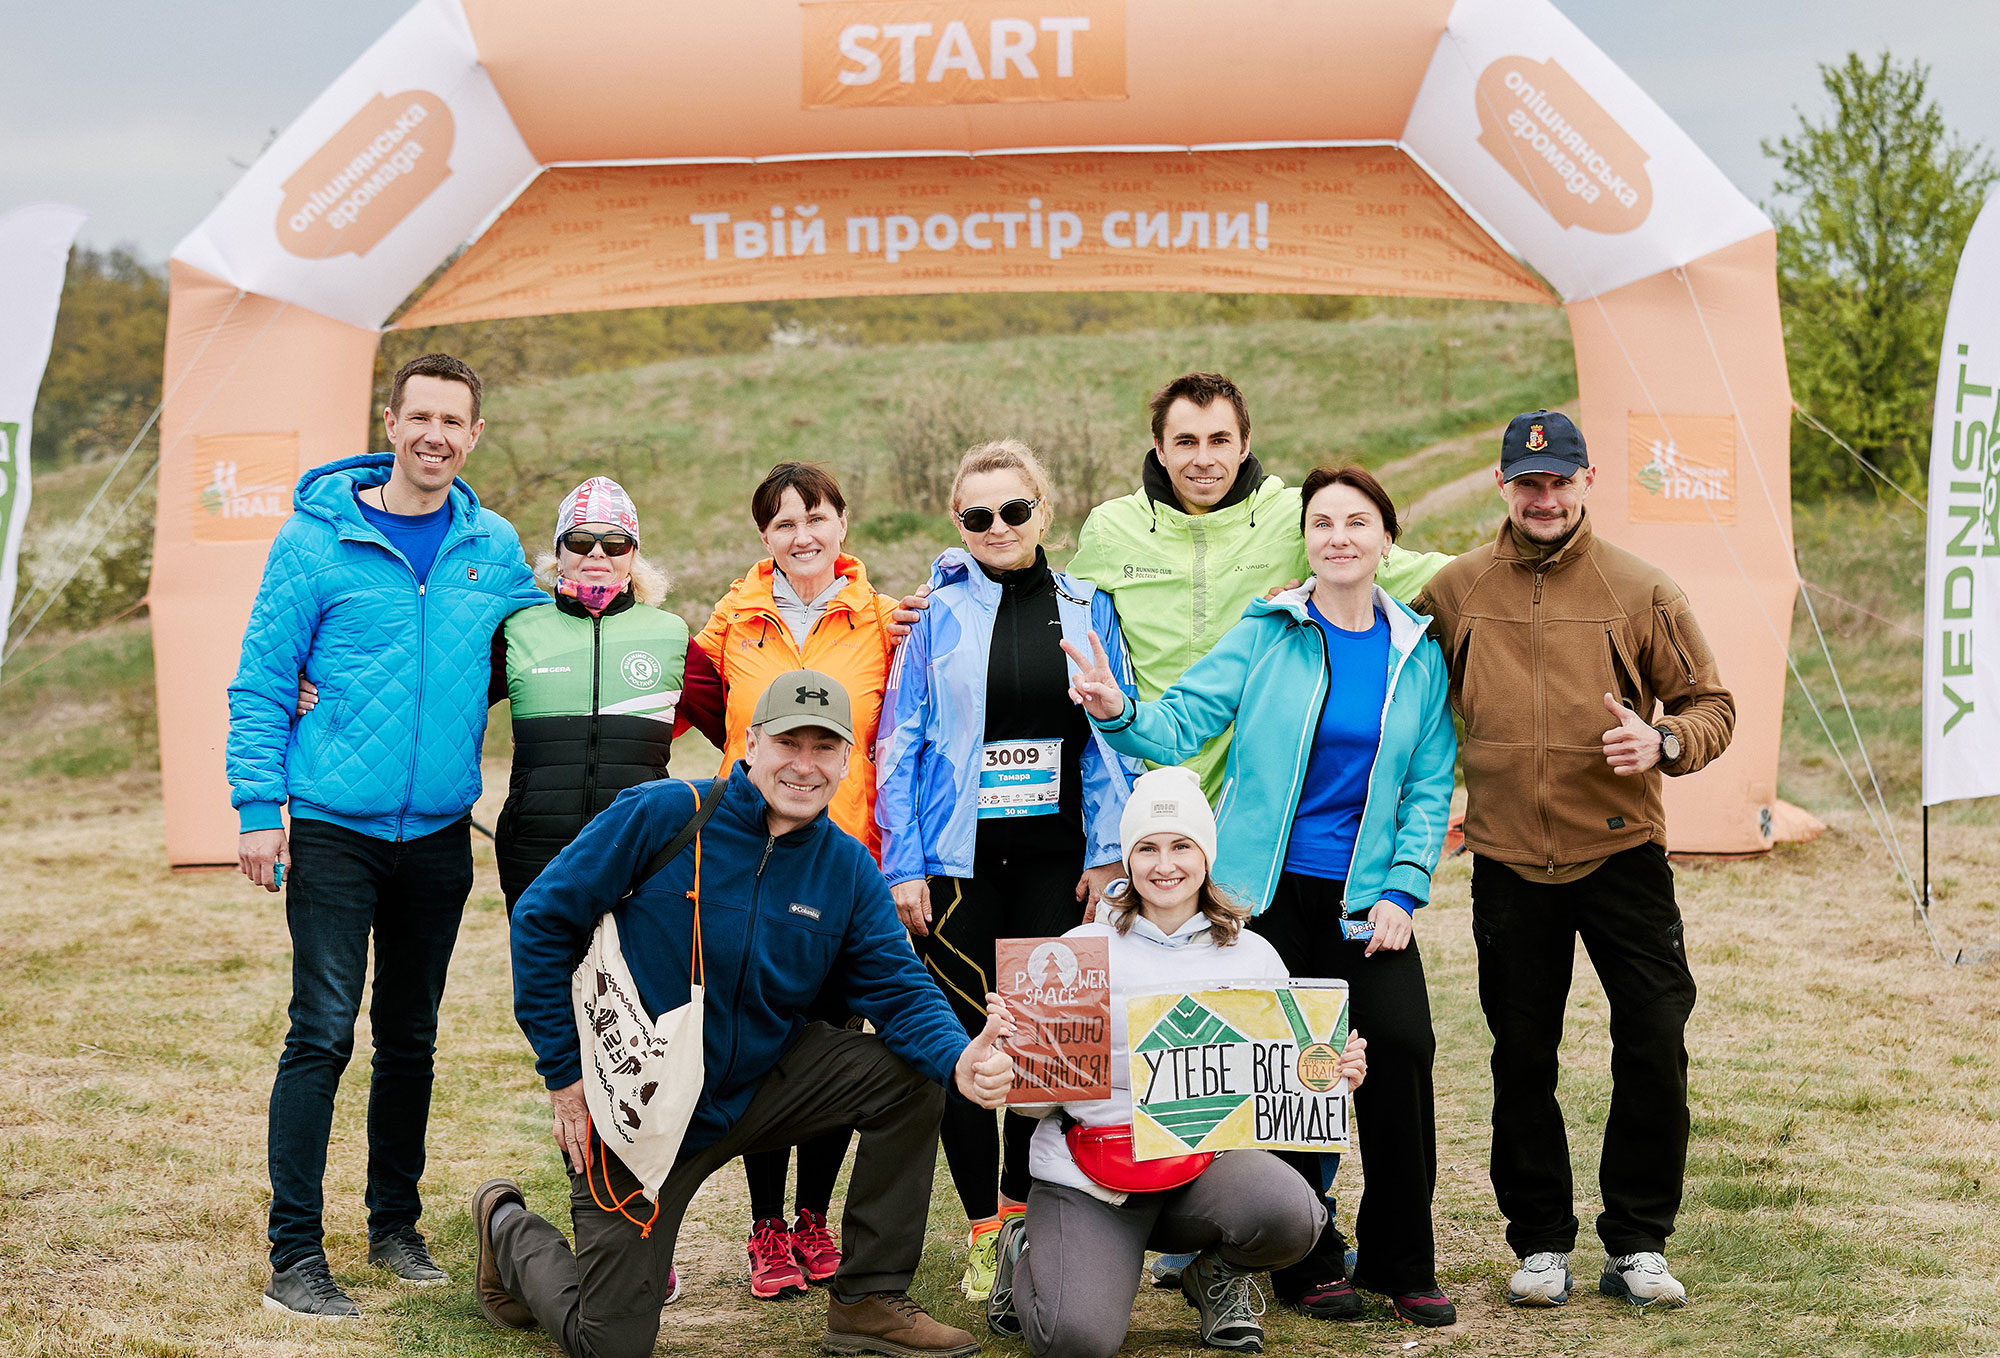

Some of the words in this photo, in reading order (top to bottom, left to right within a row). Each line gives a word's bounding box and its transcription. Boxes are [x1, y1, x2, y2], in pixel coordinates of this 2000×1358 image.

[838, 17, 1091, 86] START
[1504, 70, 1639, 209] опішнянська
[288, 103, 429, 232] опішнянська
[690, 204, 827, 260] Твій
[847, 197, 1084, 263] простір
[1102, 201, 1269, 250] сили!
[1660, 477, 1731, 500] TRAIL
[219, 495, 289, 519] TRAIL
[1136, 566, 1159, 575] RUNNING
[1160, 567, 1172, 576] CLUB
[985, 747, 1040, 767] 3009
[998, 772, 1031, 782] Тамара
[1004, 808, 1016, 816] 30
[797, 905, 820, 919] Columbia
[1022, 986, 1080, 1006] SPACE
[1252, 1042, 1294, 1094] ВСЕ
[1302, 1063, 1340, 1079] TRAIL
[1255, 1091, 1348, 1145] ВИЙДЕ!
